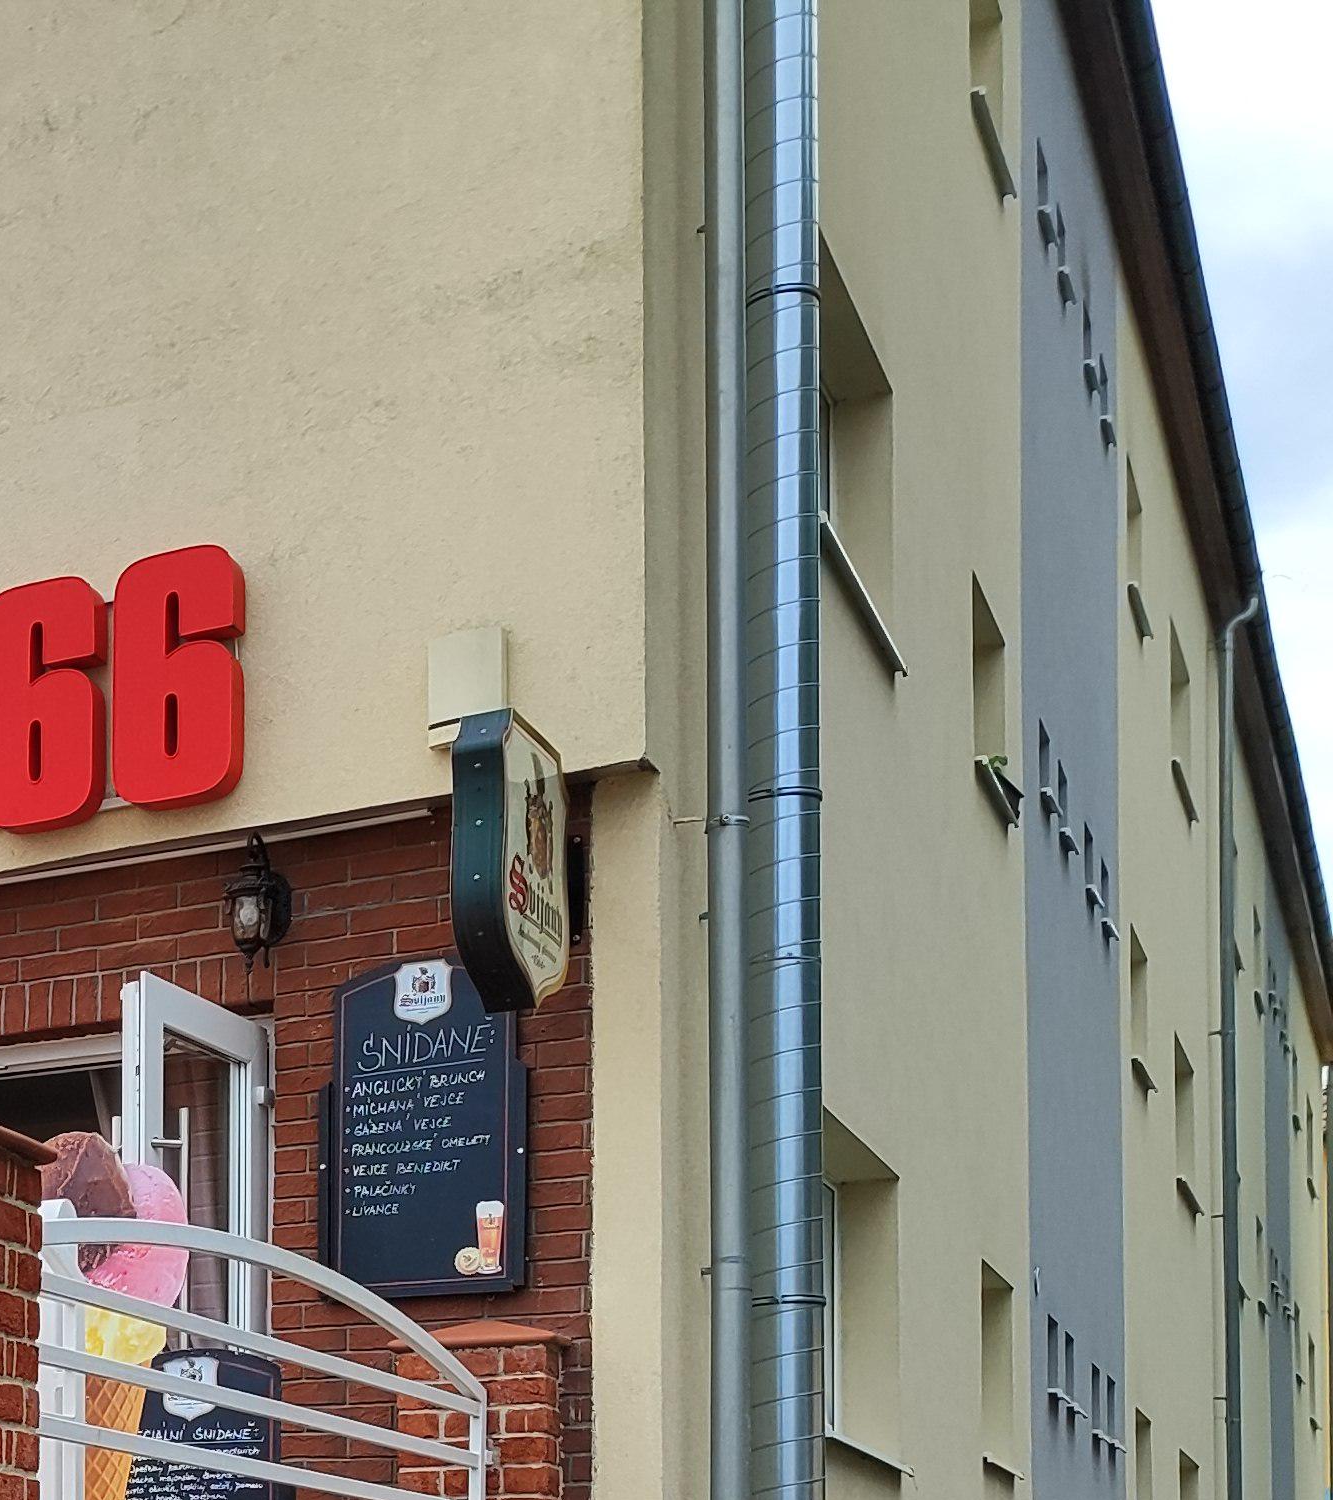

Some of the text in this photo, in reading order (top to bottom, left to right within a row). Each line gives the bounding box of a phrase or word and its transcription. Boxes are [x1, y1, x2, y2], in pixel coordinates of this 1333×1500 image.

[509, 852, 563, 950] Svijany
[429, 1070, 486, 1089] BRUNCH
[423, 1092, 465, 1108] VEJCE
[414, 1116, 452, 1131] VEJCE
[352, 1159, 461, 1177] VEJCE BENEDIKT
